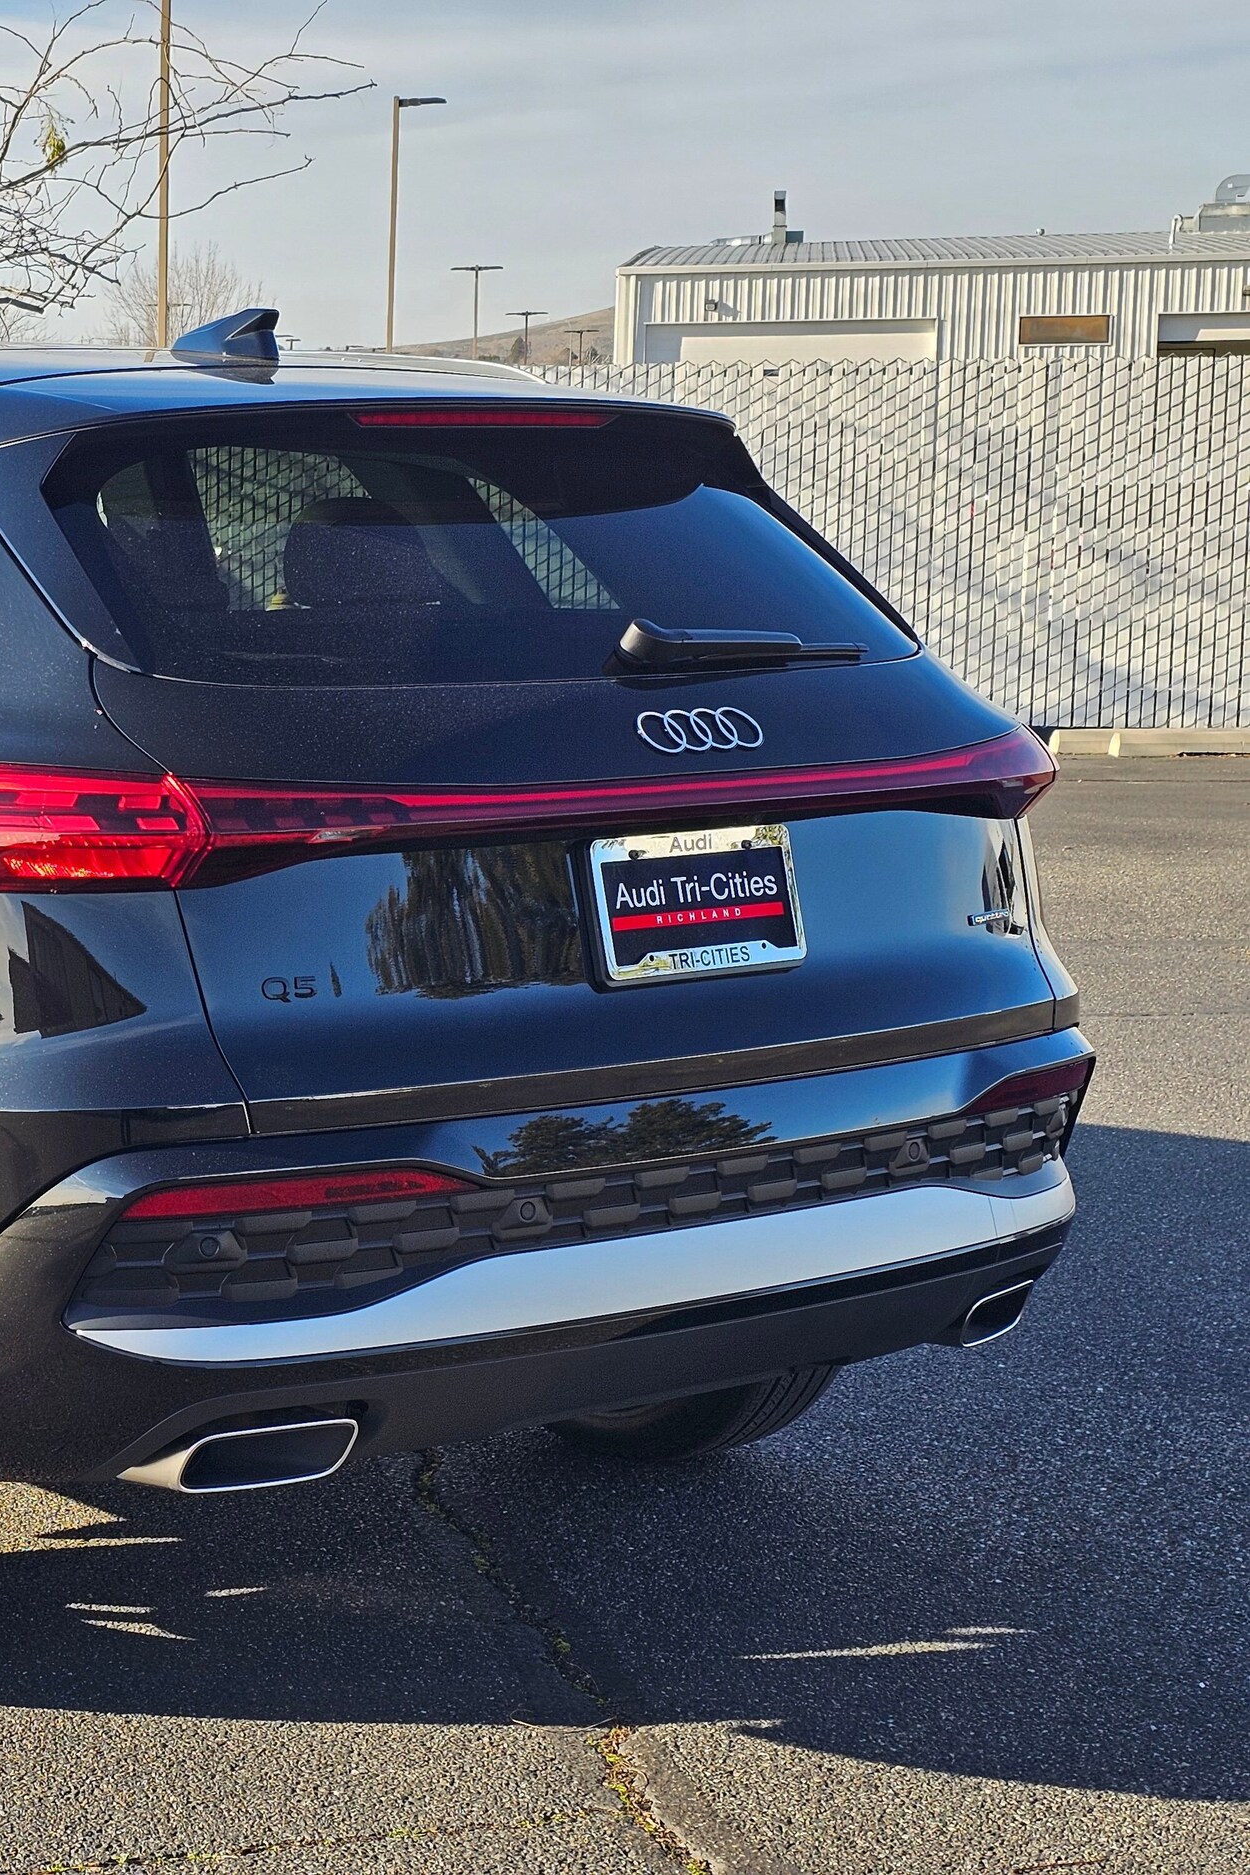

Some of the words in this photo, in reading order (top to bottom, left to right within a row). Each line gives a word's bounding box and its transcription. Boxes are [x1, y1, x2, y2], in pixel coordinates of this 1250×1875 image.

[669, 834, 713, 853] Audi
[616, 879, 666, 910] Audi
[670, 871, 778, 904] Tri-Cities
[656, 907, 742, 925] RICHLAND
[669, 946, 750, 970] TRI-CITIES
[261, 975, 317, 1003] Q5
